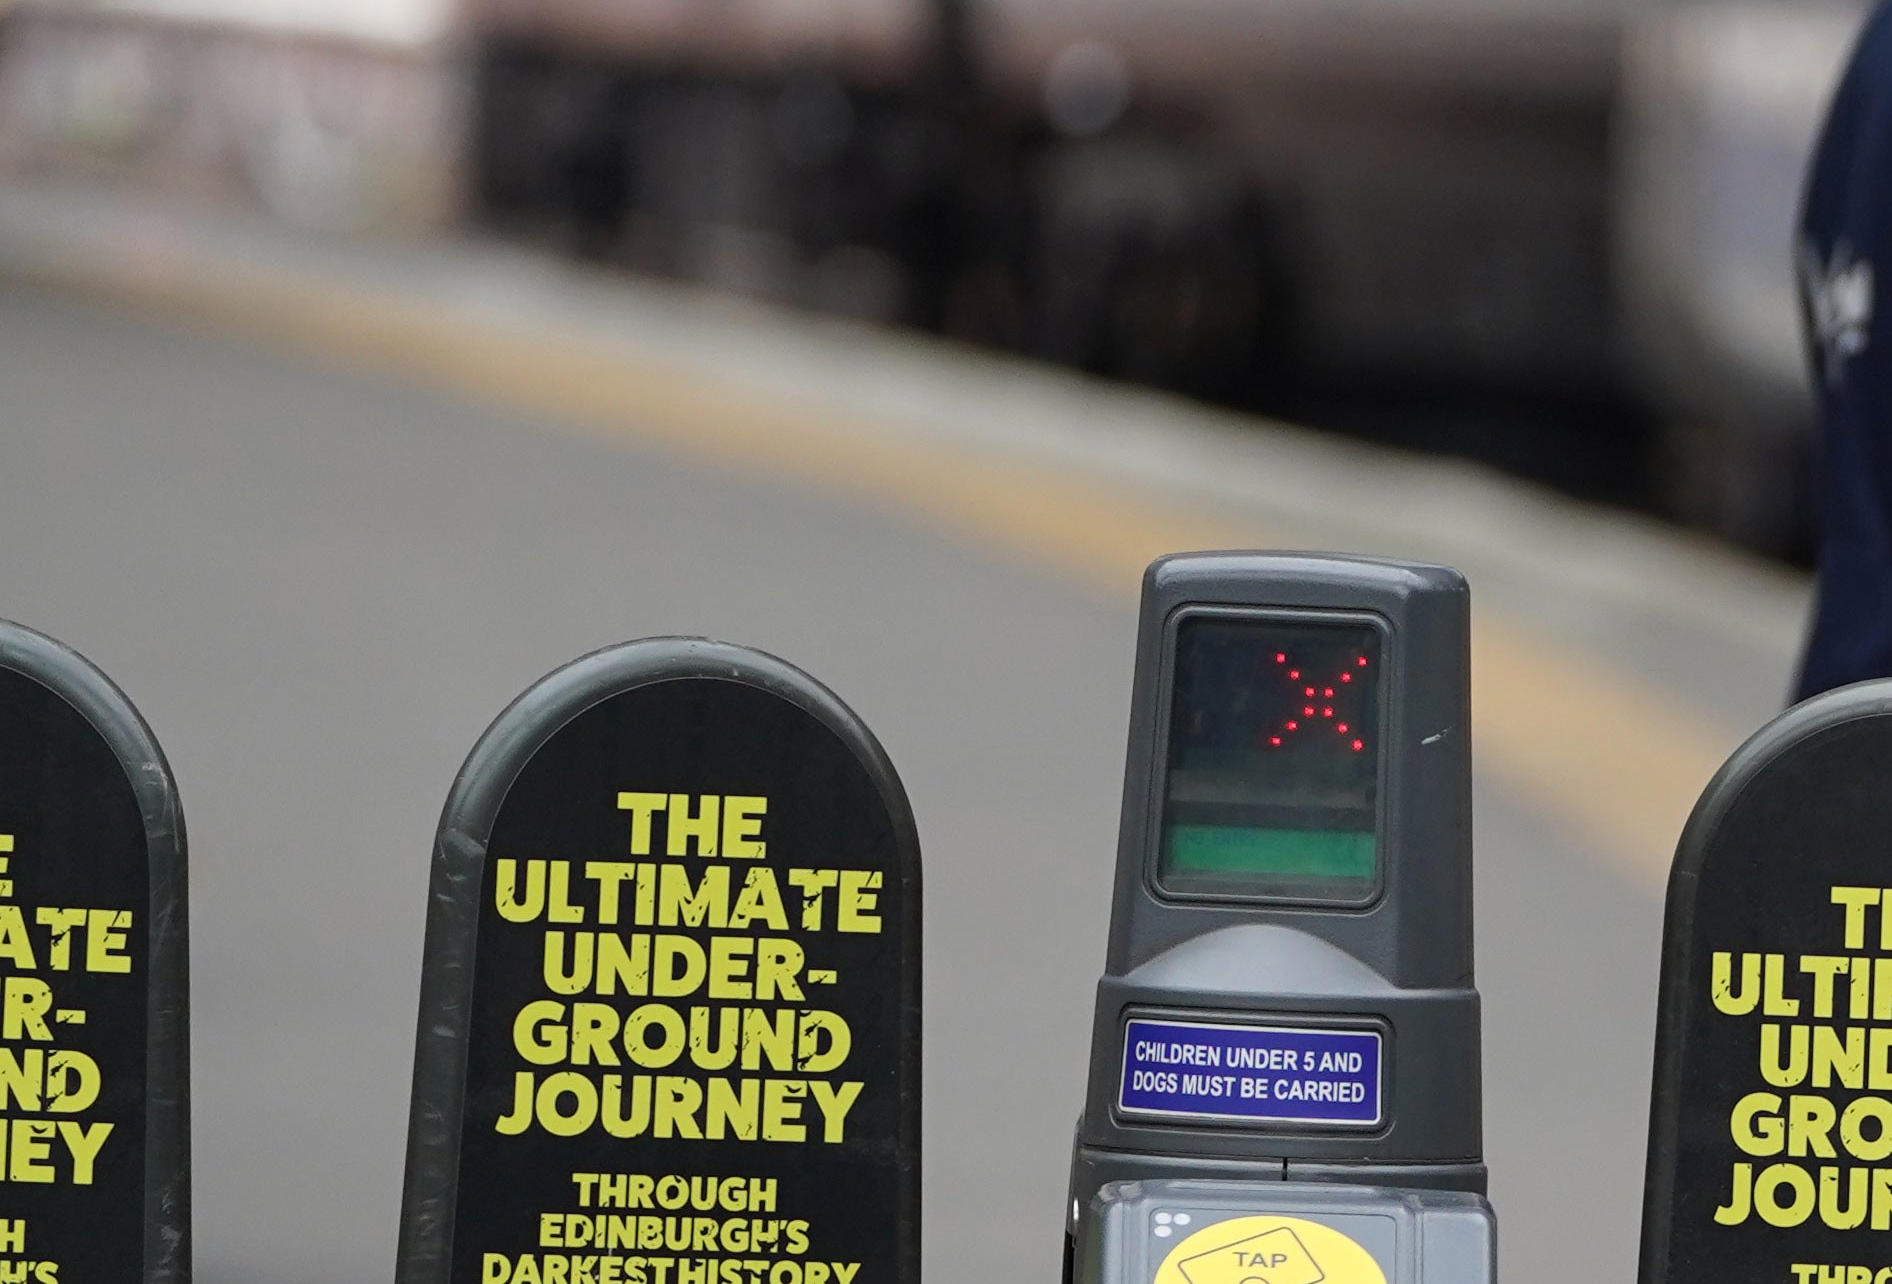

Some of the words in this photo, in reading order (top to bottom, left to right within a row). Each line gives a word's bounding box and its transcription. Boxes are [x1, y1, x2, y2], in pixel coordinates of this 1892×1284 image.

[618, 792, 767, 858] THE
[496, 859, 882, 933] ULTIMATE
[544, 931, 837, 1001] UNDER-
[513, 1001, 851, 1072] GROUND
[1135, 1040, 1222, 1067] CHILDREN
[1226, 1046, 1298, 1071] UNDER
[1302, 1051, 1315, 1072] 5
[1319, 1051, 1362, 1073] AND
[496, 1072, 863, 1143] JOURNEY
[1133, 1069, 1178, 1094] DOGS
[1182, 1073, 1235, 1098] MUST
[1240, 1076, 1269, 1099] BE
[1273, 1079, 1365, 1103] CARRIED
[573, 1173, 776, 1211] THROUGH
[540, 1214, 809, 1254] EDINBURGH'S
[1232, 1251, 1287, 1269] TAP
